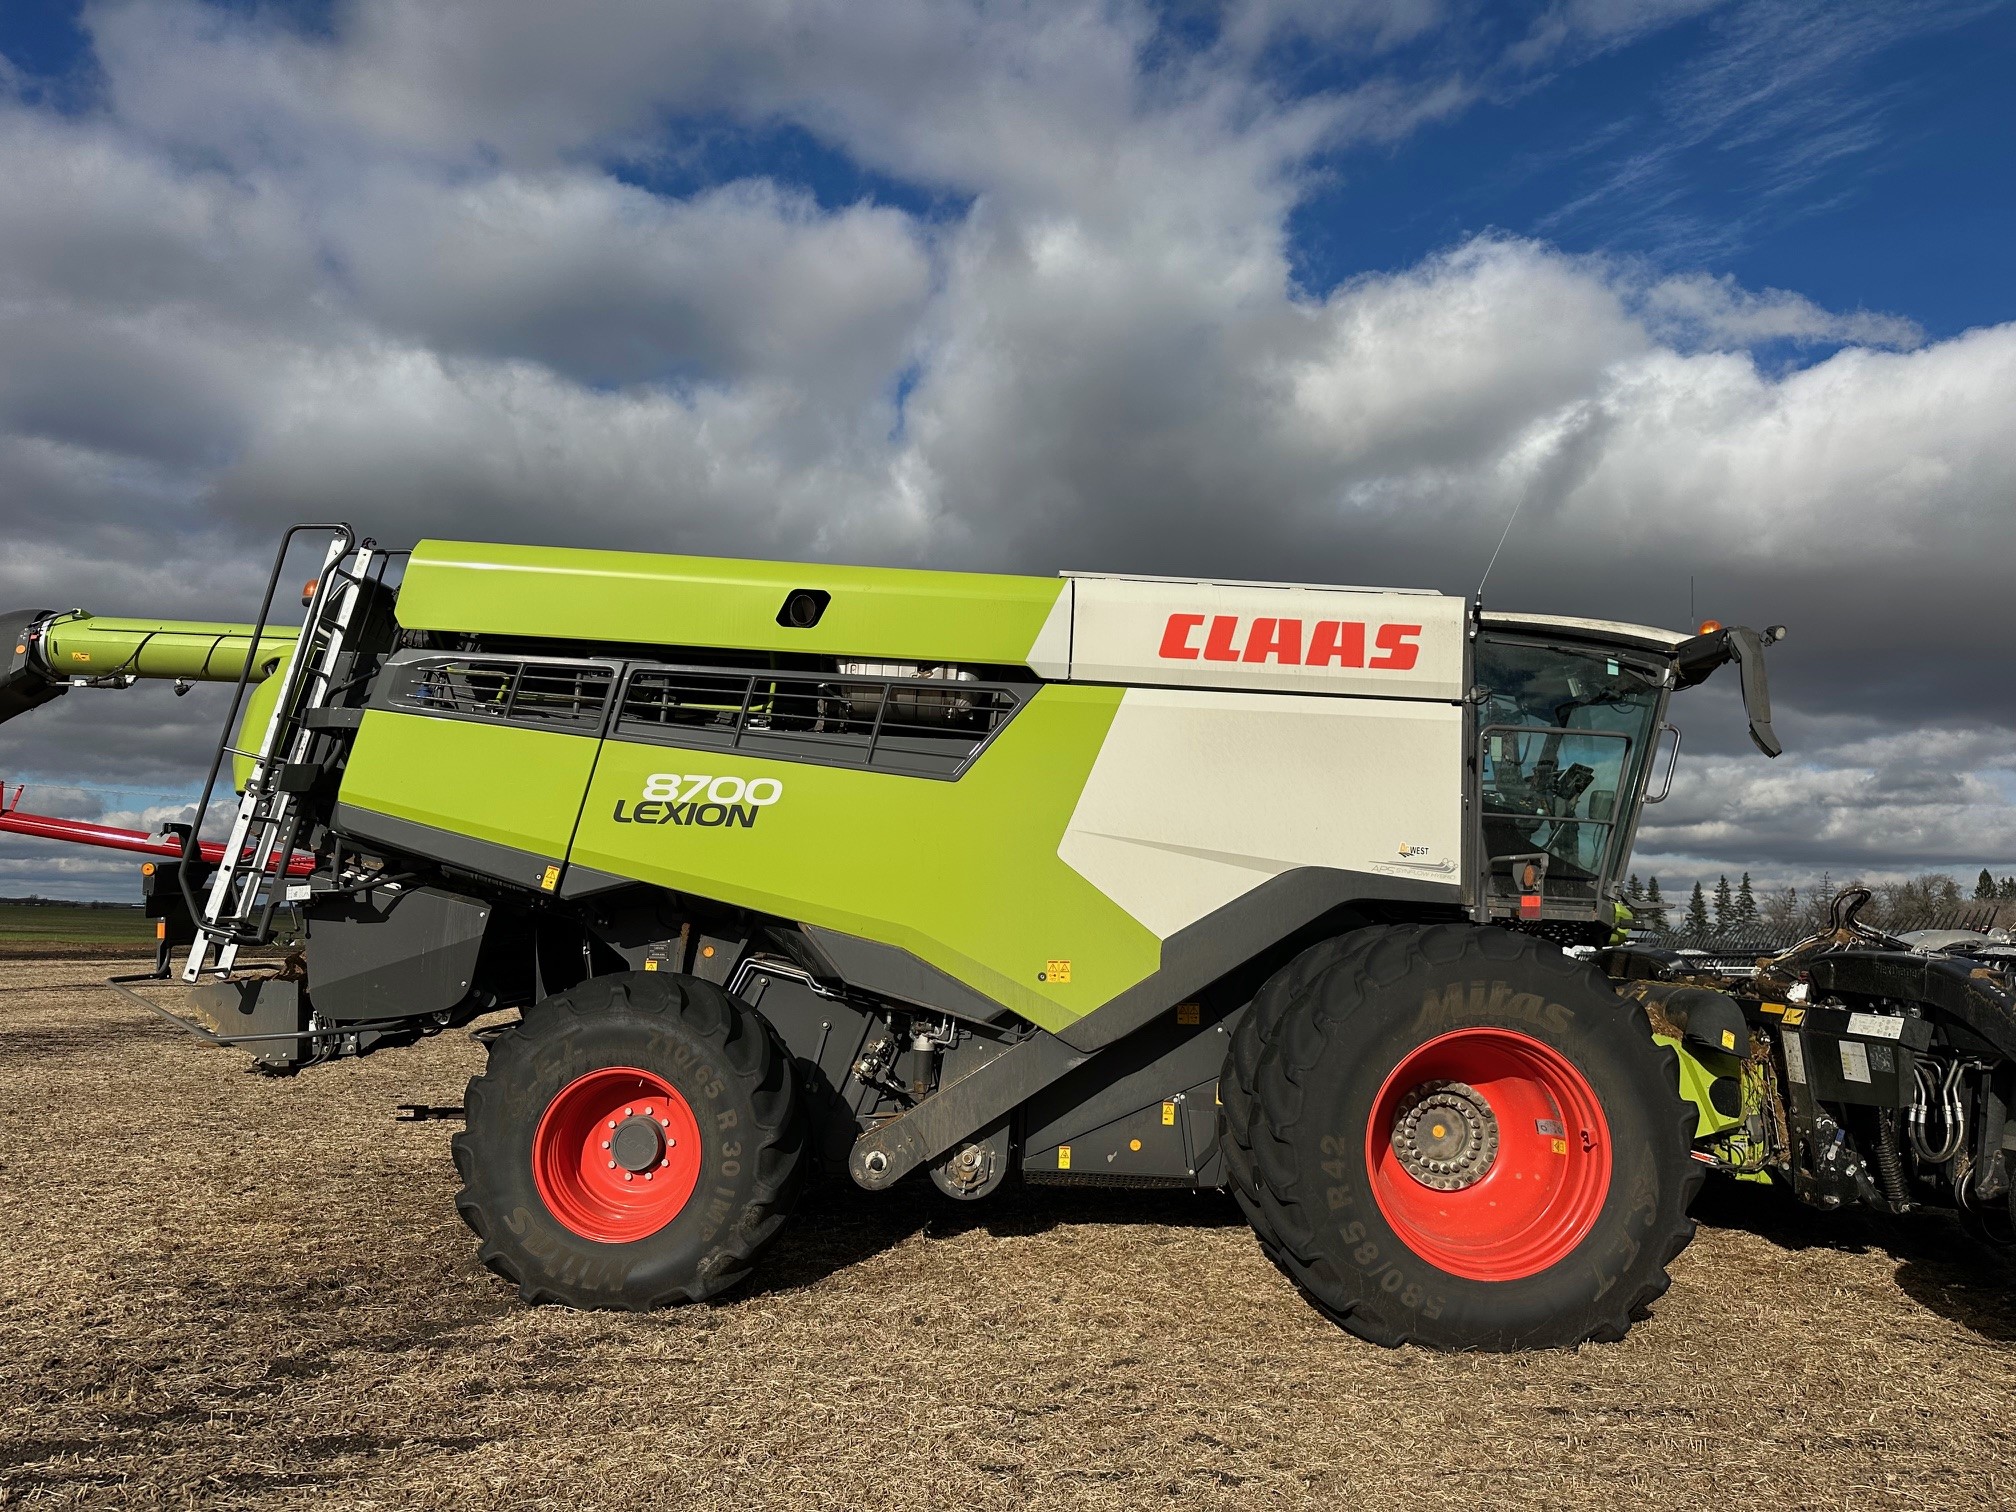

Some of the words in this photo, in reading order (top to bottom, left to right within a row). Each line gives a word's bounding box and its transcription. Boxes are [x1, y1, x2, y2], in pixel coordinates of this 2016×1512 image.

[1158, 613, 1423, 671] CLAAS
[642, 773, 783, 806] 8700
[613, 800, 759, 828] LEXION
[1371, 864, 1396, 875] APS
[1412, 980, 1575, 1034] Mitas
[1319, 1133, 1346, 1178] 42
[1326, 1184, 1353, 1211] R
[502, 1204, 644, 1292] Mitas
[1338, 1219, 1448, 1321] 580/85
